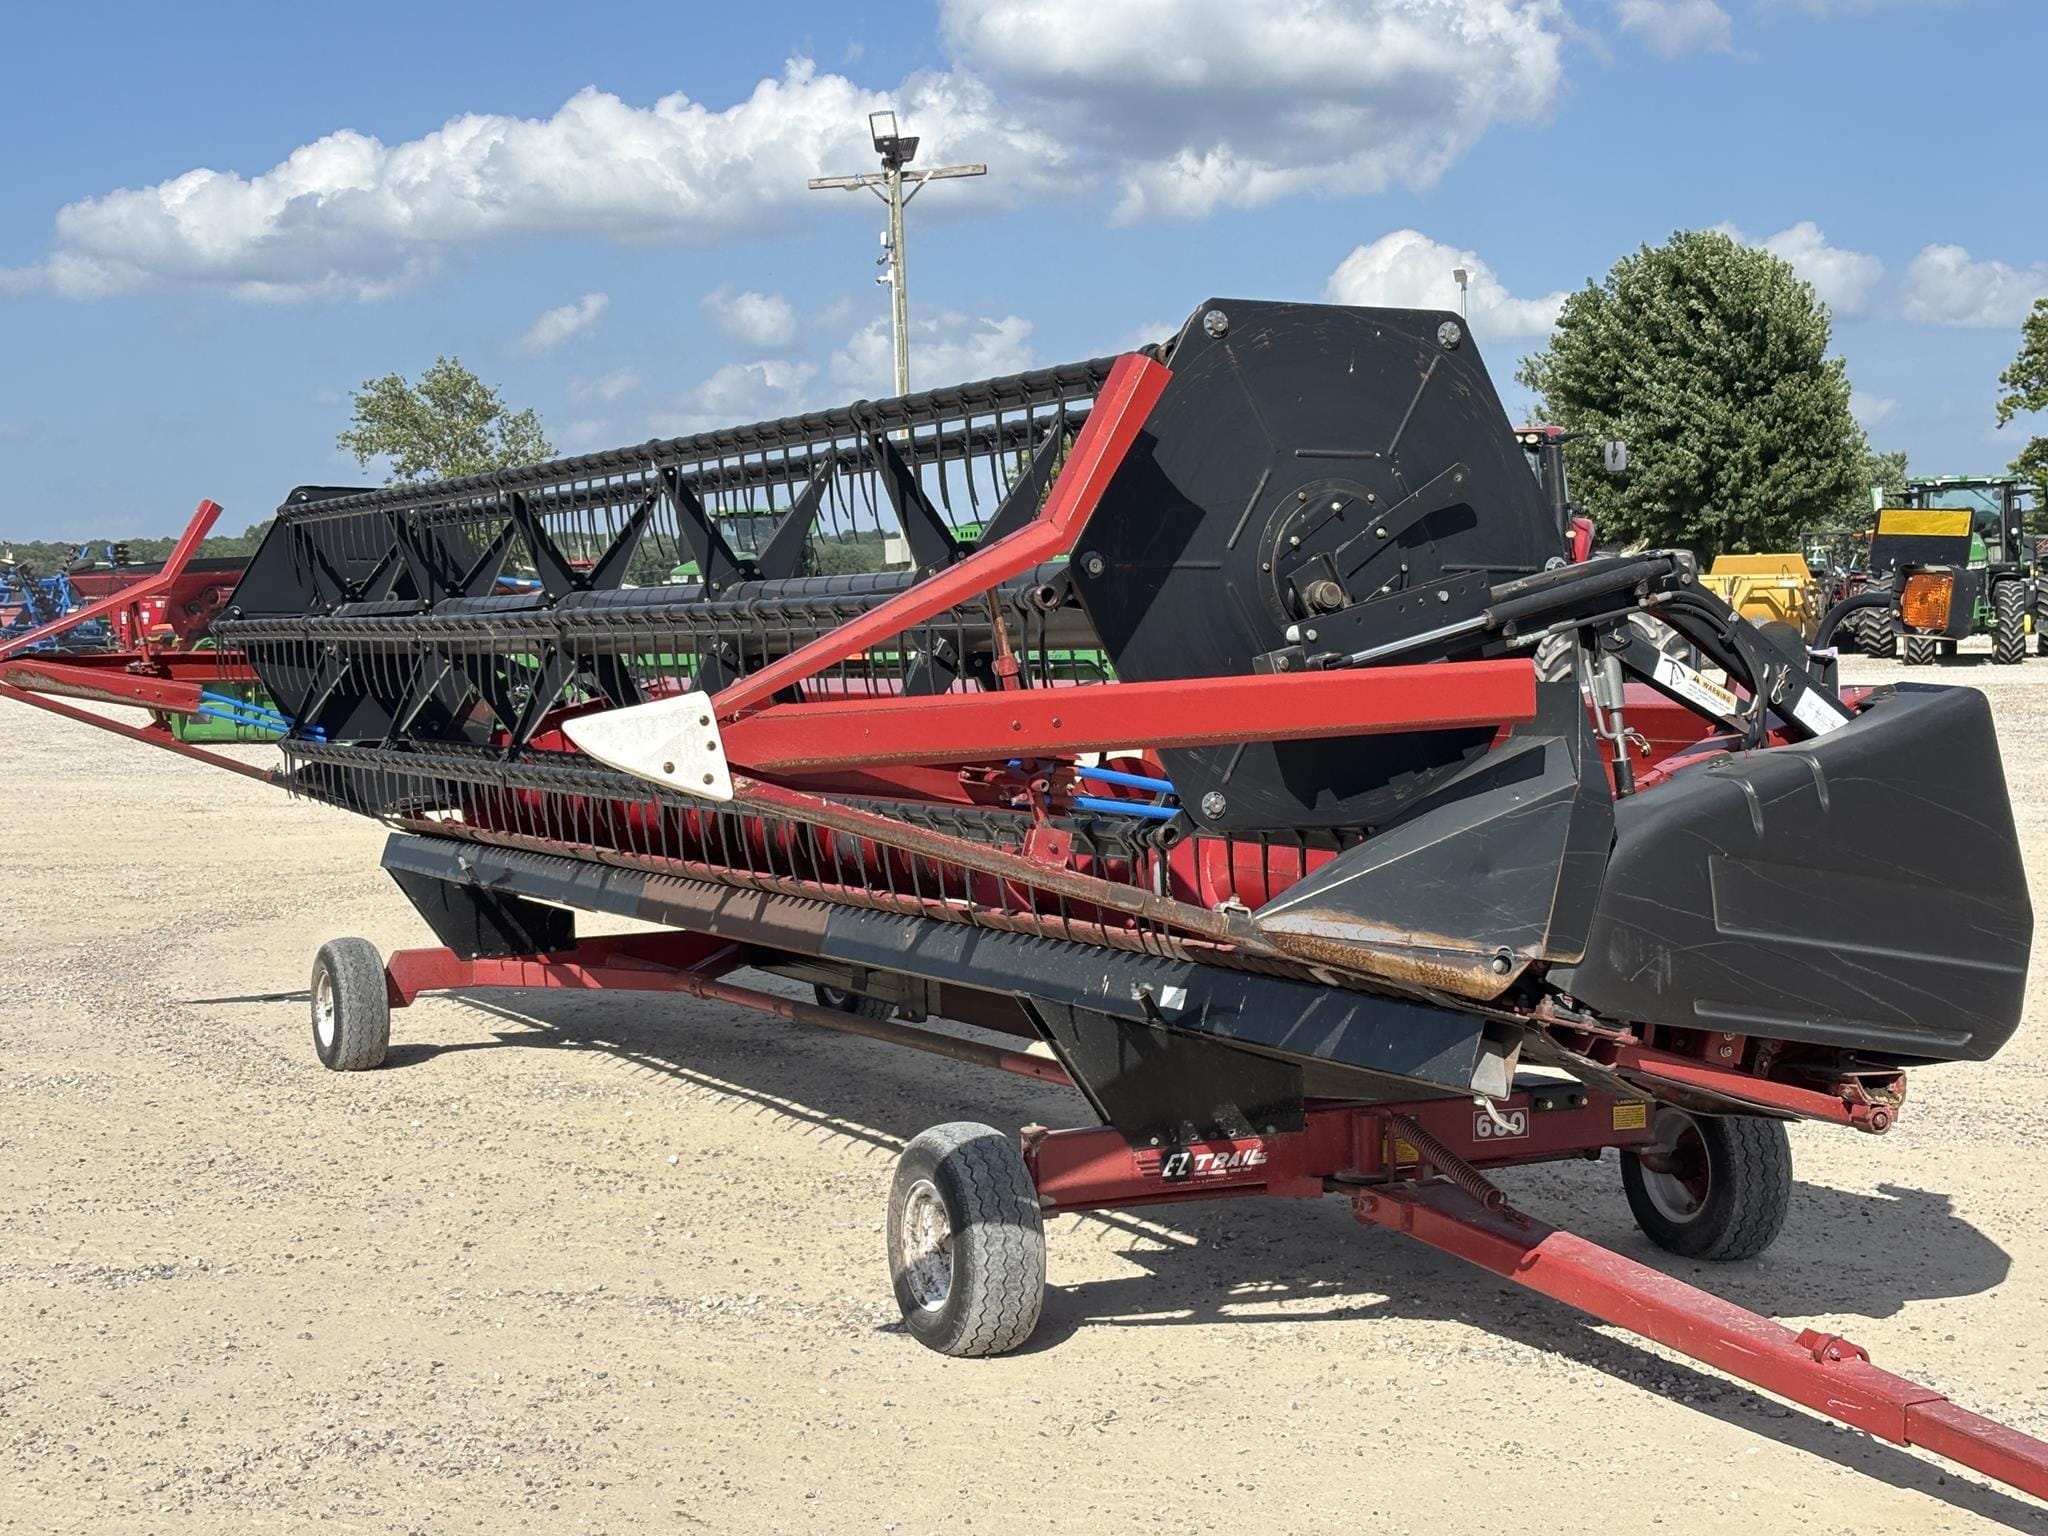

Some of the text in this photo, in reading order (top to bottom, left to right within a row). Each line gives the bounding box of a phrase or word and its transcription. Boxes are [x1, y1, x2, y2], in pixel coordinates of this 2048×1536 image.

[1702, 681, 1731, 703] WARNING
[1476, 1111, 1525, 1137] 680
[1195, 1149, 1267, 1170] TRAIL
